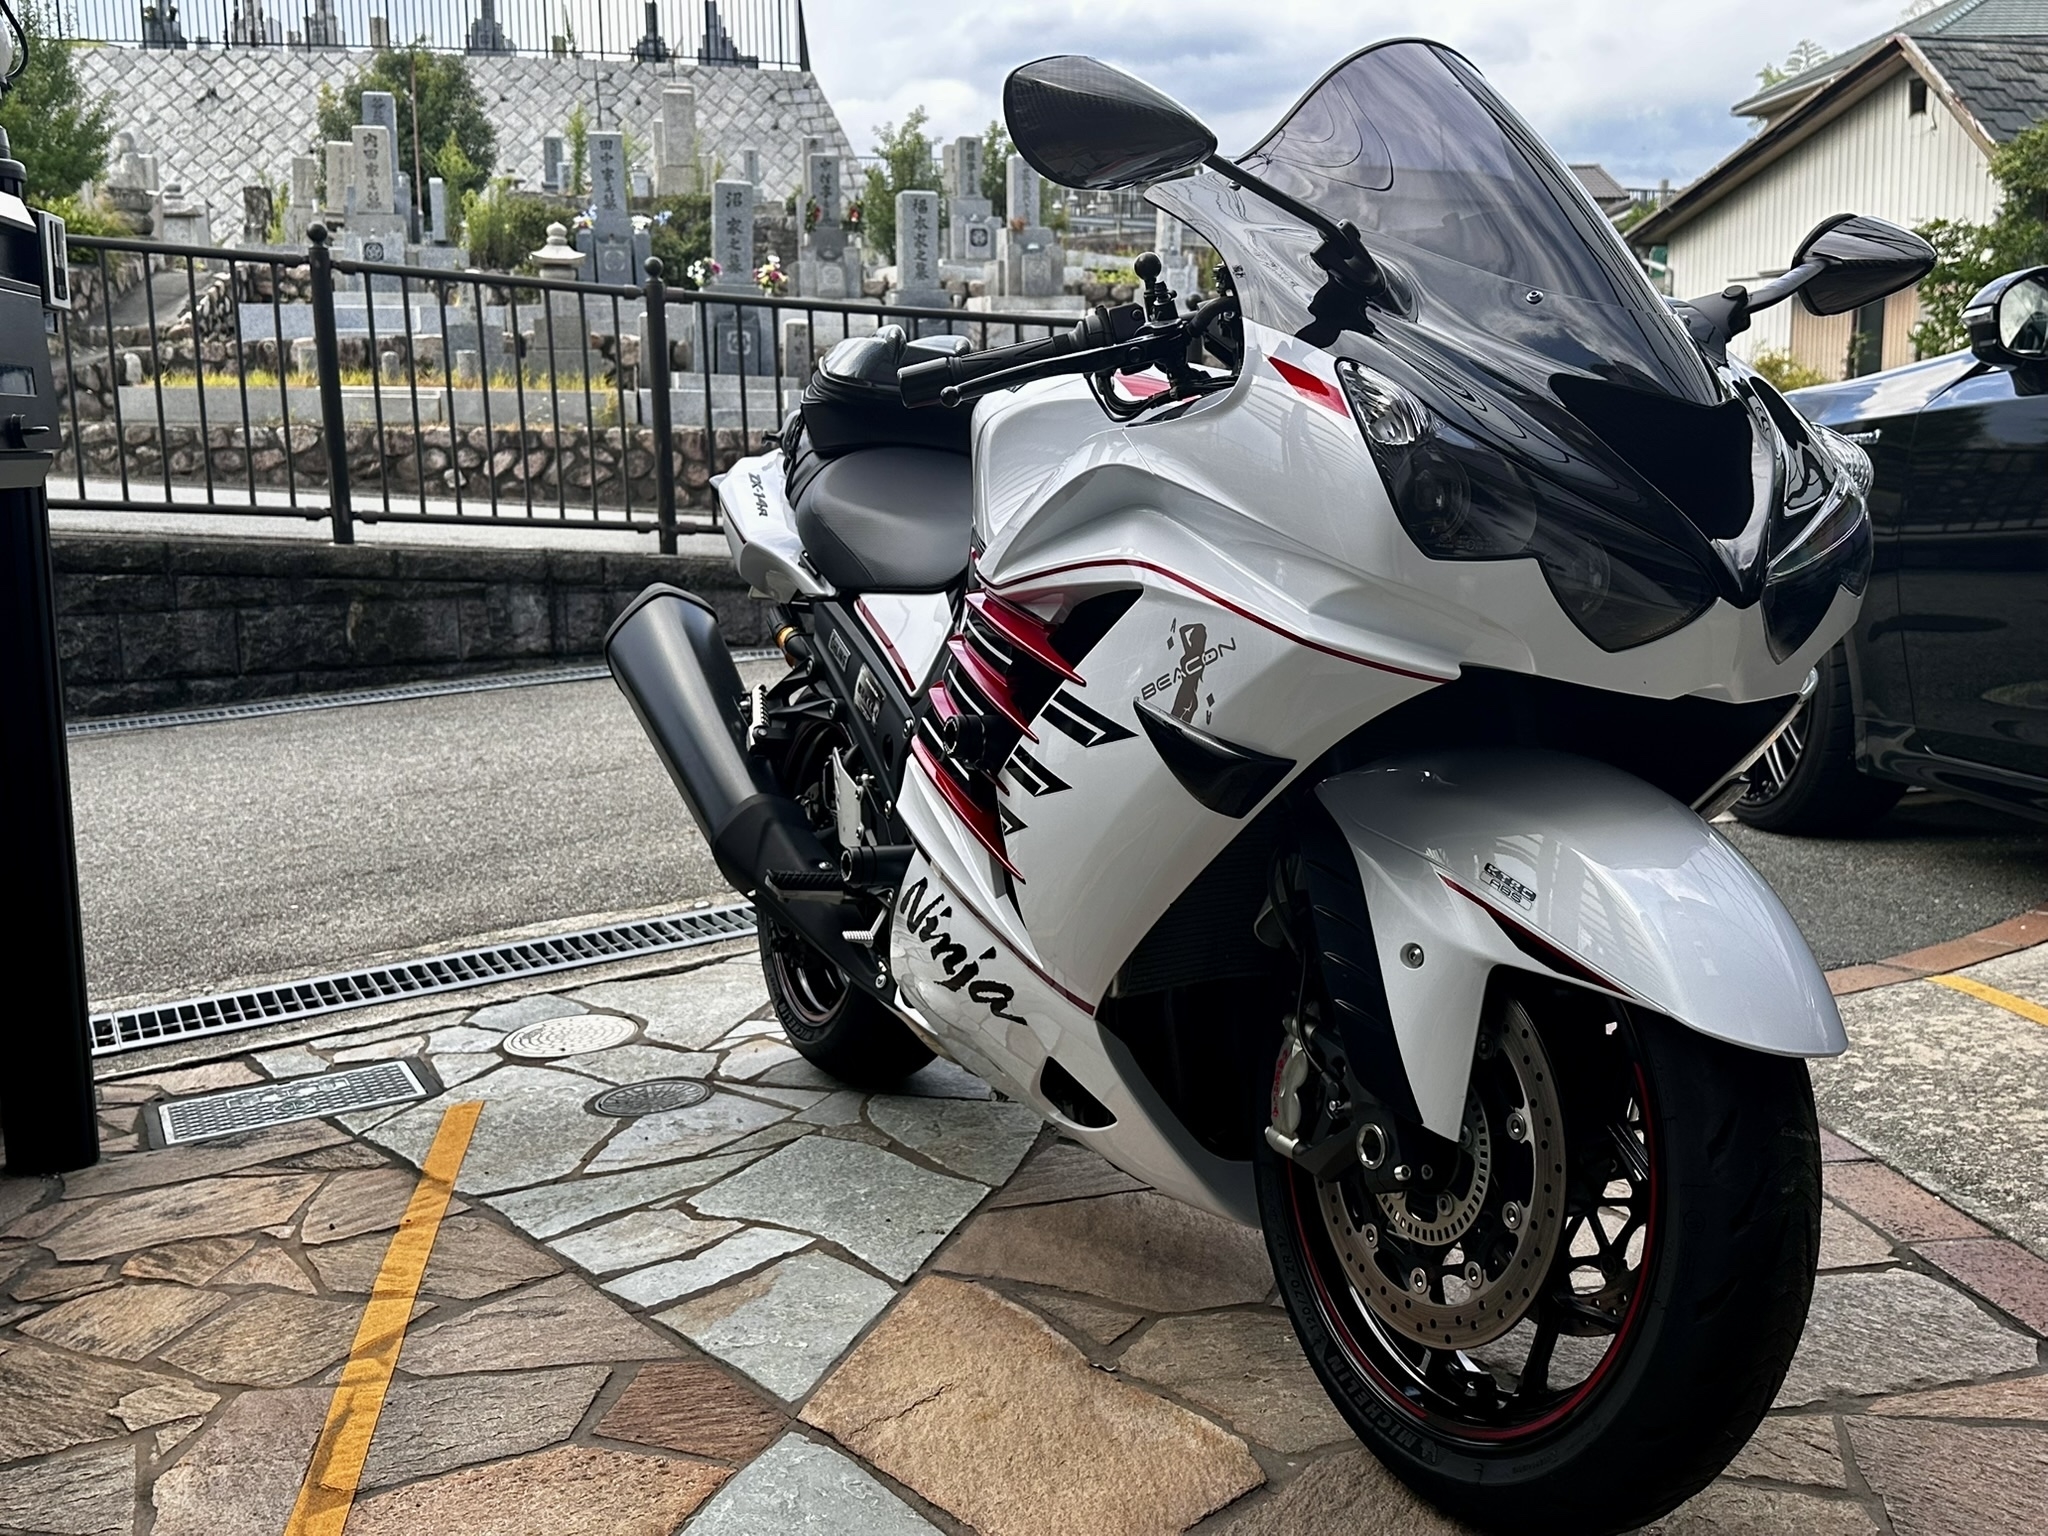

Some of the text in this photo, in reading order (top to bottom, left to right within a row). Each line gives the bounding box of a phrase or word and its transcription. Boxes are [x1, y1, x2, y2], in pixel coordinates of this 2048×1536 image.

[748, 472, 769, 517] ZX-14R
[1141, 636, 1237, 701] BEACON
[1489, 878, 1522, 904] ABS
[900, 876, 1028, 1026] Ninja
[1282, 1254, 1296, 1274] ZR
[1290, 1279, 1319, 1331] 120/70
[1327, 1354, 1419, 1449] MICHELIN
